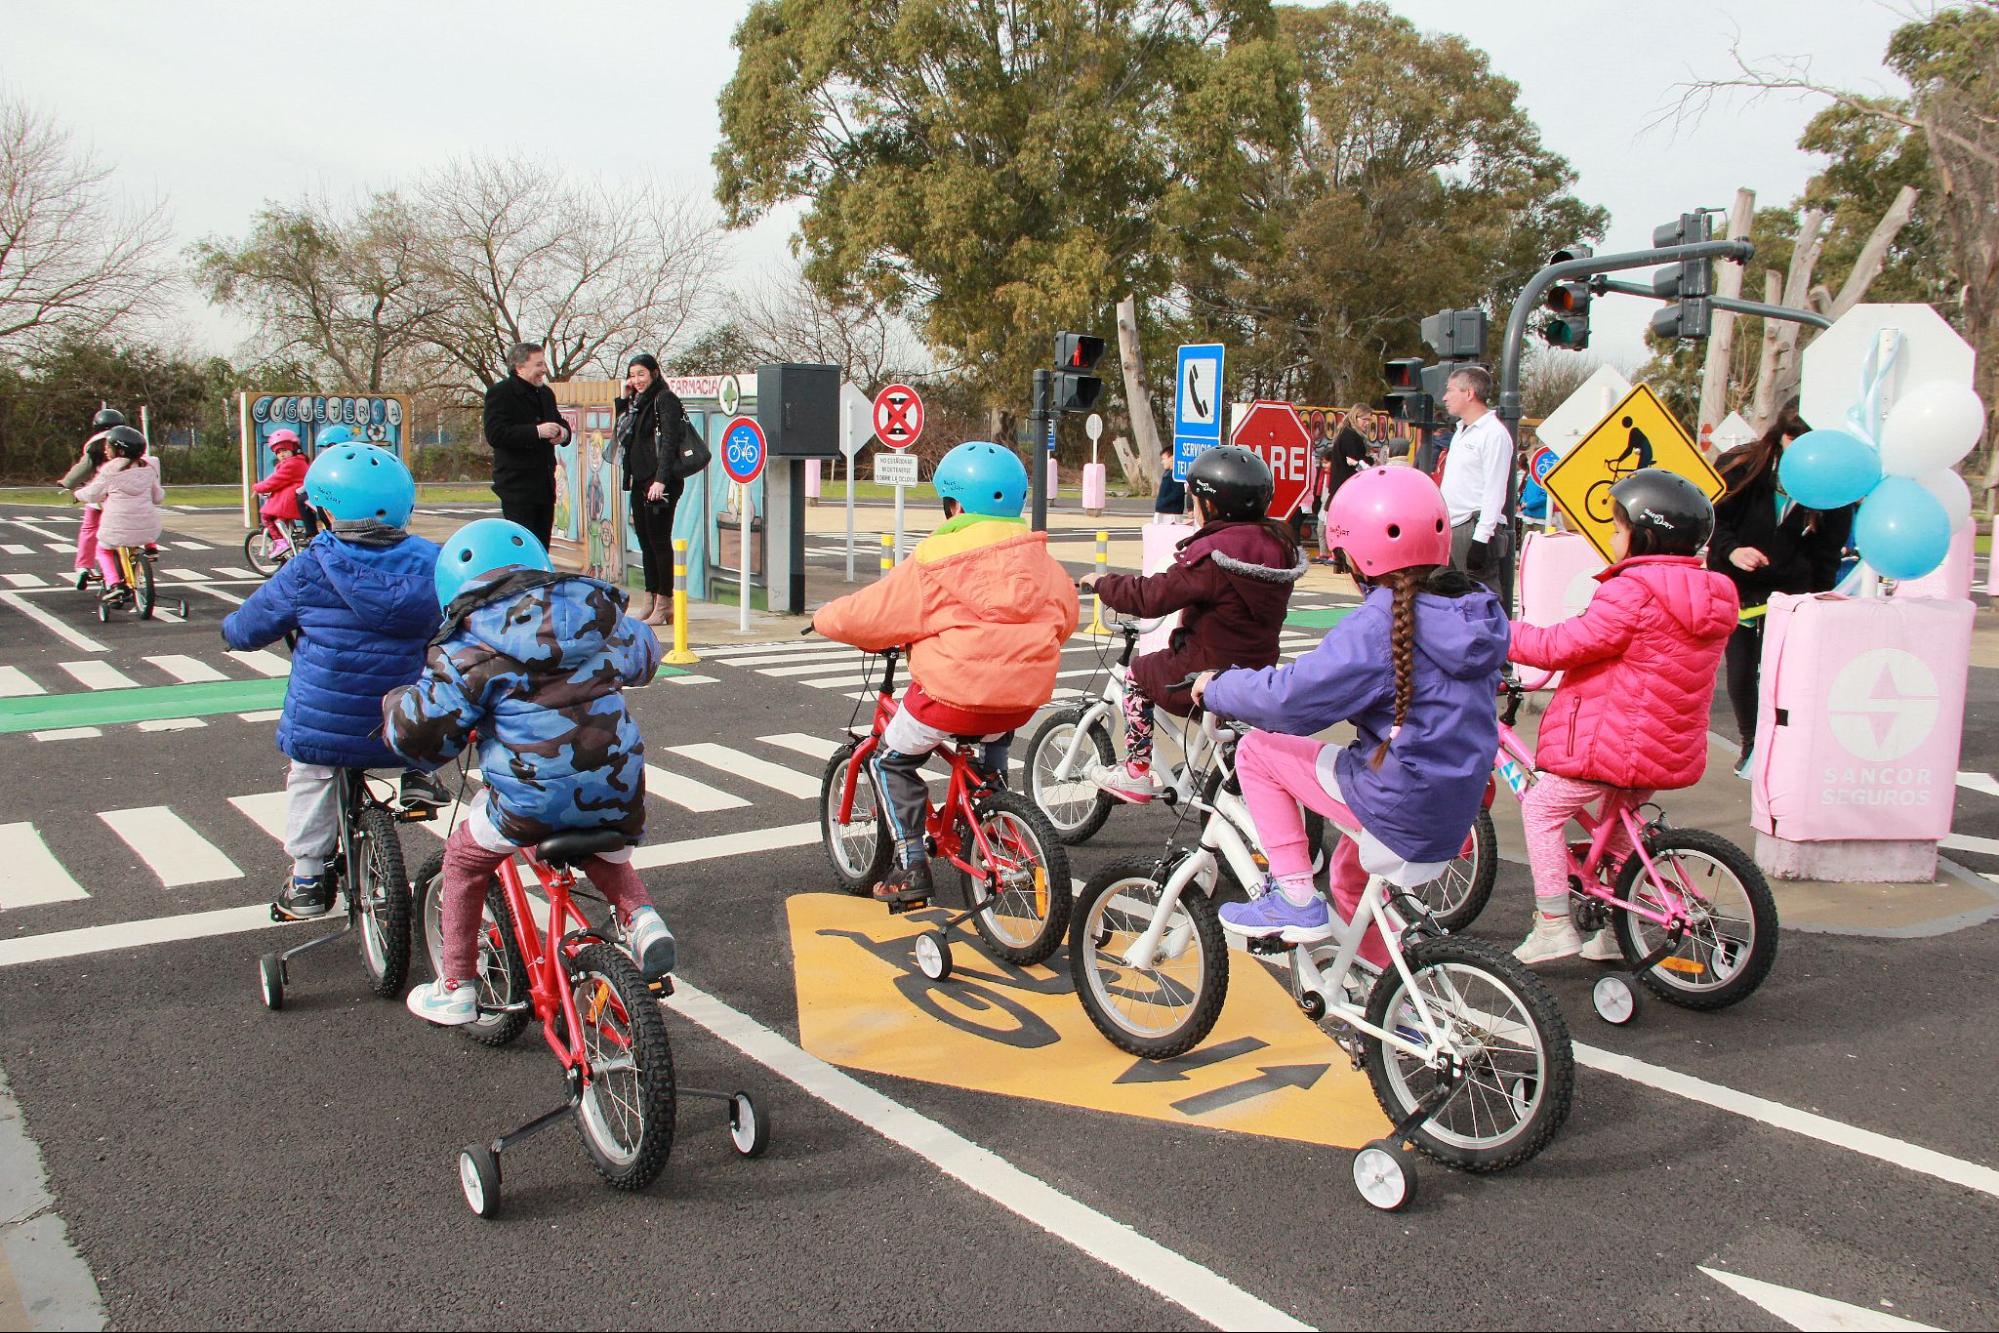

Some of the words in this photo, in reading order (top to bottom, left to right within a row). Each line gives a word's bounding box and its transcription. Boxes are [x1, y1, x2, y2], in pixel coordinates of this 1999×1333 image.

[670, 379, 718, 395] FARMACIA
[1181, 443, 1211, 457] SERVIC
[1823, 767, 1932, 785] SANCOR
[1822, 788, 1931, 806] SEGUROS
